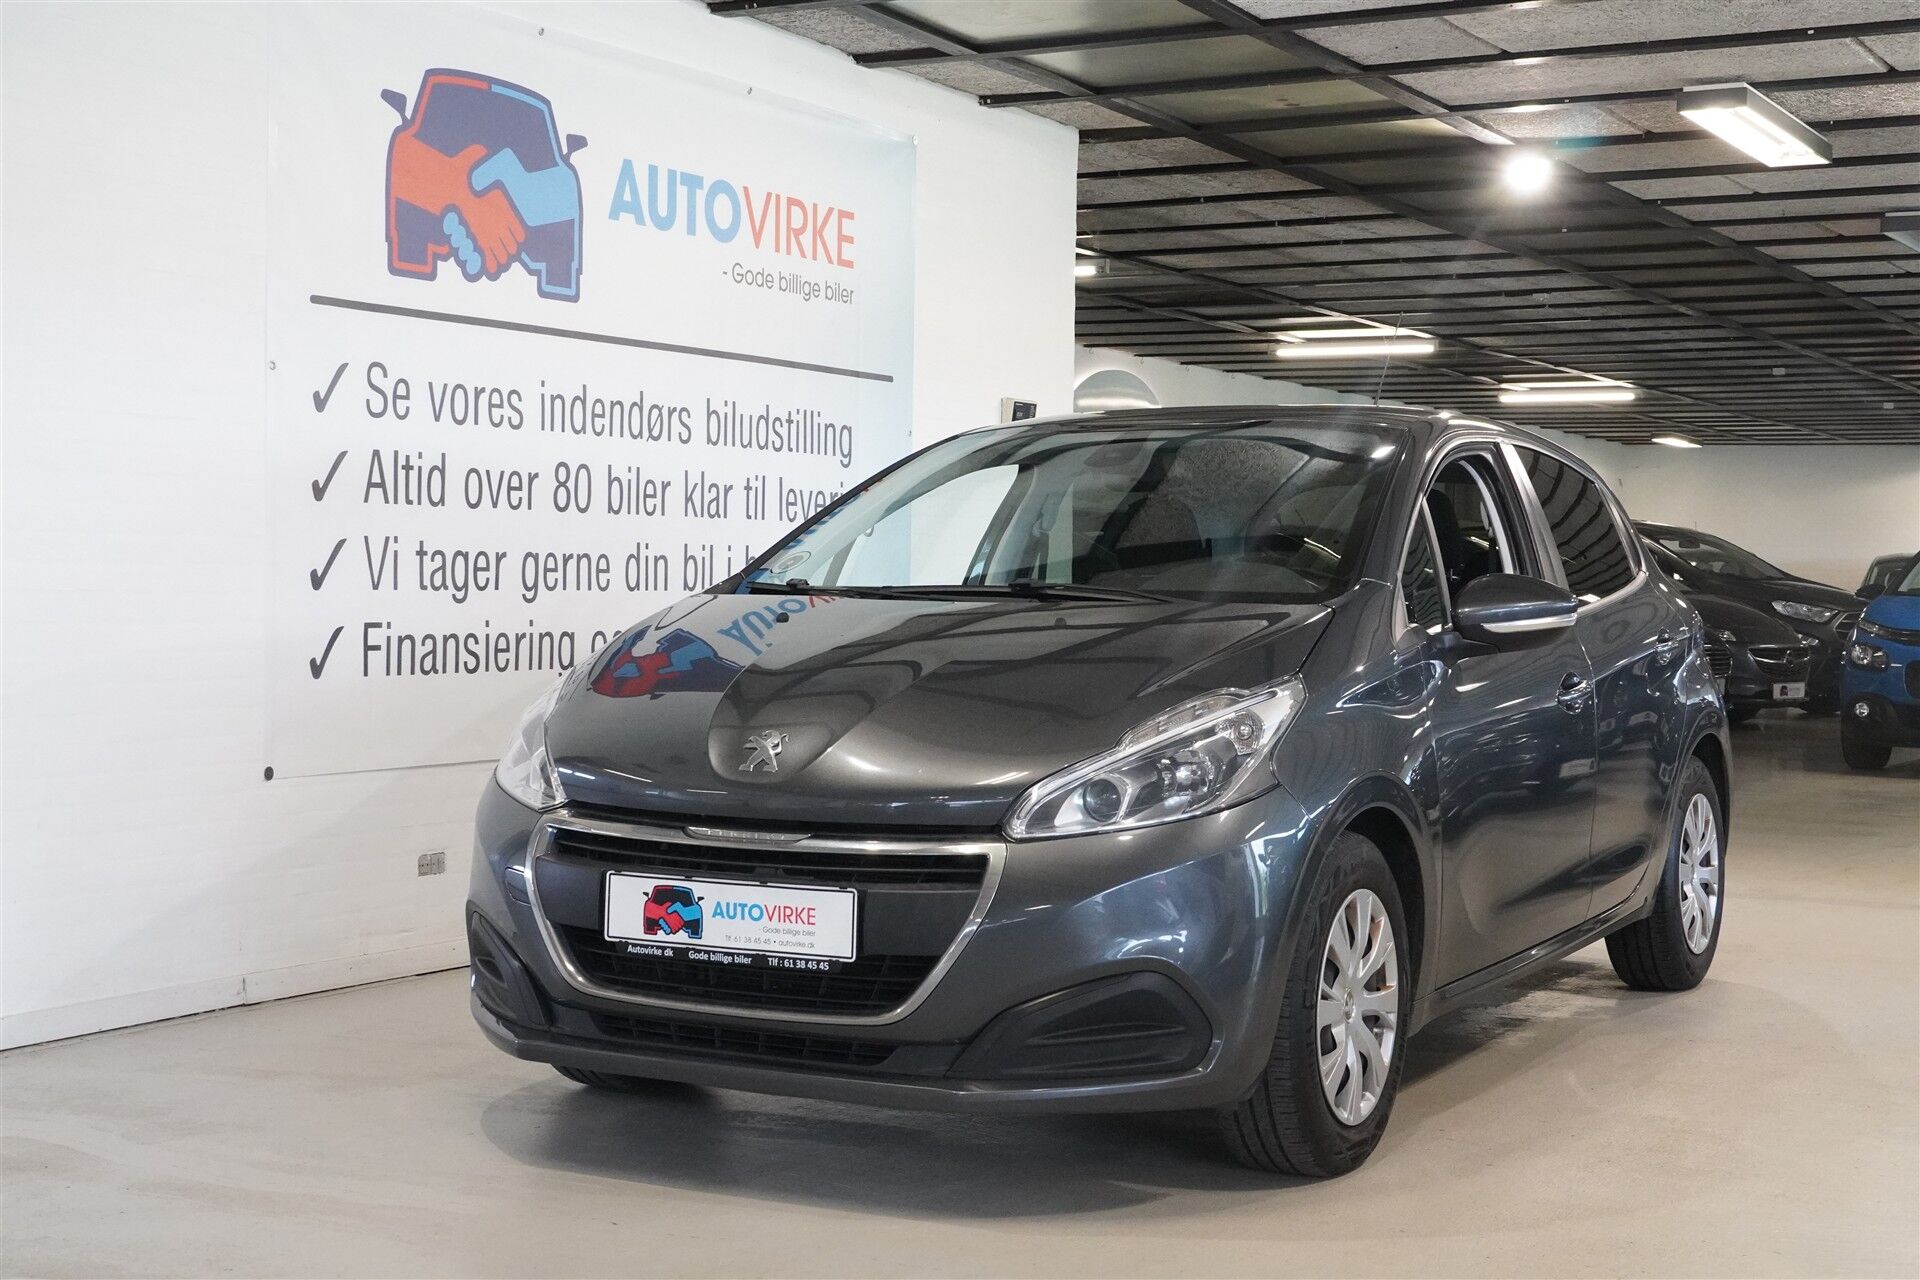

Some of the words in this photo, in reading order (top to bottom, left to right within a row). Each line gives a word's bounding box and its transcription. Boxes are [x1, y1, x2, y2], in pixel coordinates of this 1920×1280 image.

[608, 158, 855, 269] AUTOVIRKE
[732, 262, 774, 290] Gode
[778, 271, 821, 302] billige
[824, 280, 854, 304] biler
[365, 361, 411, 420] Se
[428, 381, 524, 430] vores
[540, 380, 692, 444] indendørs
[706, 398, 853, 468] biludstilling
[363, 448, 447, 508] Altid
[464, 467, 540, 512] over
[553, 461, 592, 514] 80
[607, 465, 672, 517] biler
[684, 470, 734, 520] klar
[744, 474, 766, 521] til
[363, 535, 399, 592] Vi
[416, 541, 508, 605] tager
[521, 551, 611, 604] gerne
[624, 541, 669, 593] din
[683, 543, 713, 592] bil
[362, 619, 575, 678] Finansiering
[712, 901, 816, 925] AUTOVIRKE
[627, 944, 662, 956] Autovirke
[688, 950, 709, 961] Gode
[710, 953, 733, 964] billige
[734, 955, 752, 965] biler
[784, 958, 794, 968] 61
[795, 959, 806, 969] 38
[807, 960, 817, 970] 45
[818, 961, 829, 971] 45
